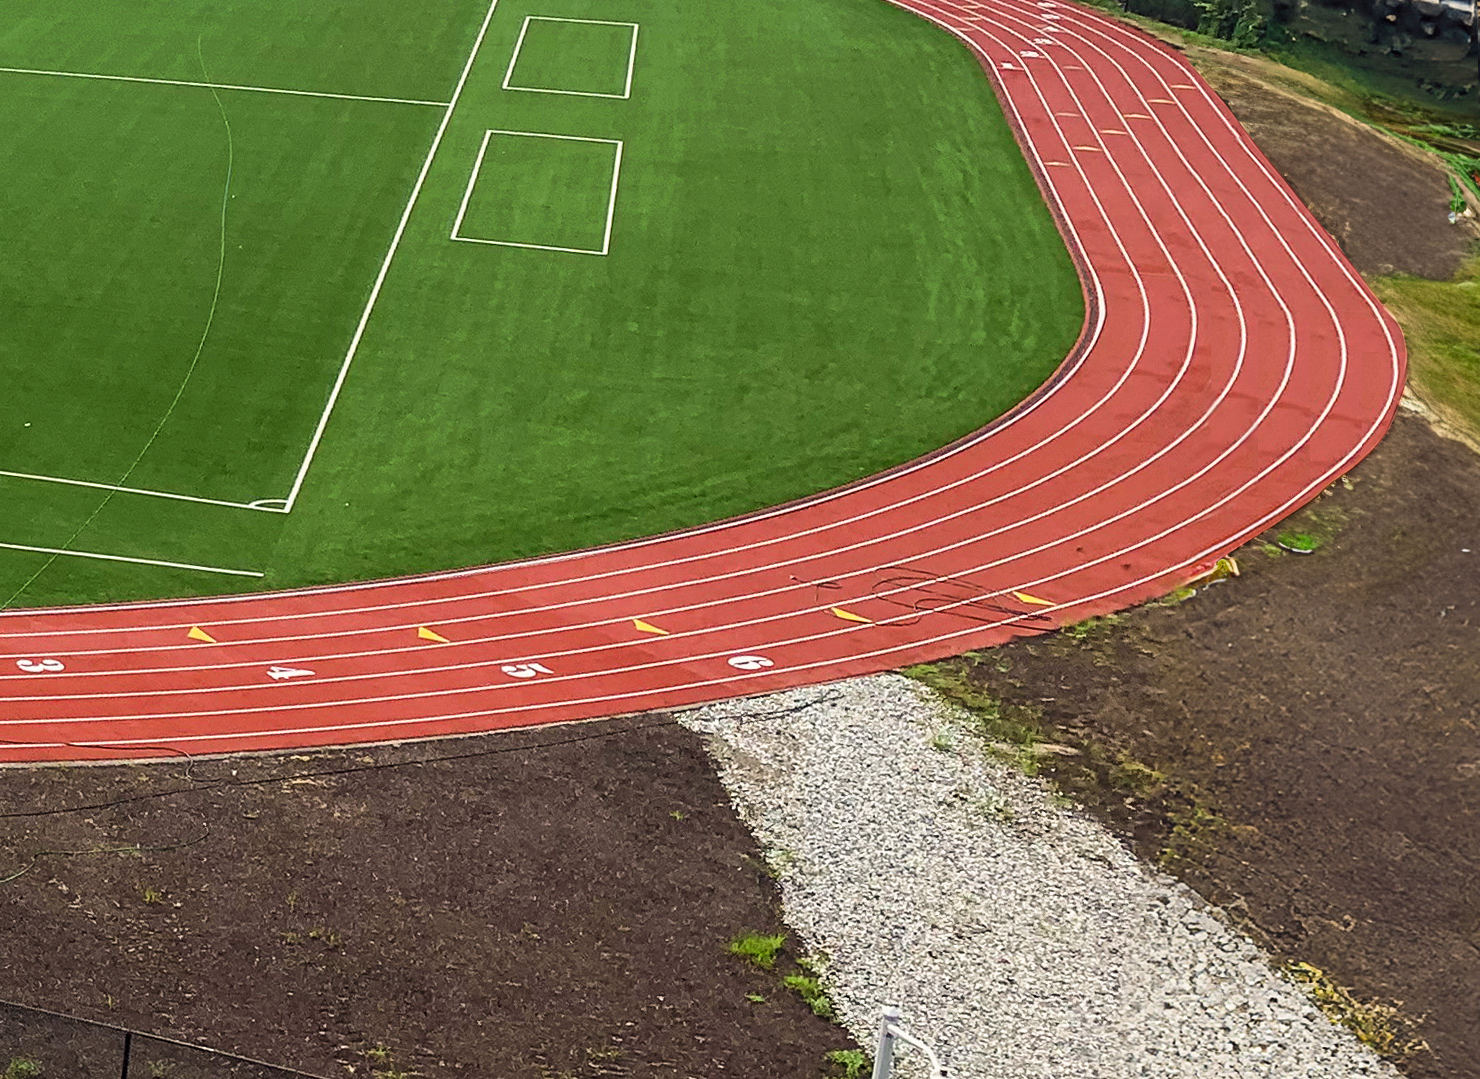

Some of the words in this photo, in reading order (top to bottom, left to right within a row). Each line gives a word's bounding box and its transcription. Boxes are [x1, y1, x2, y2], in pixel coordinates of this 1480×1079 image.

[16, 659, 65, 673] 3
[727, 655, 774, 670] 6
[266, 666, 316, 680] 4
[501, 663, 555, 678] 5
